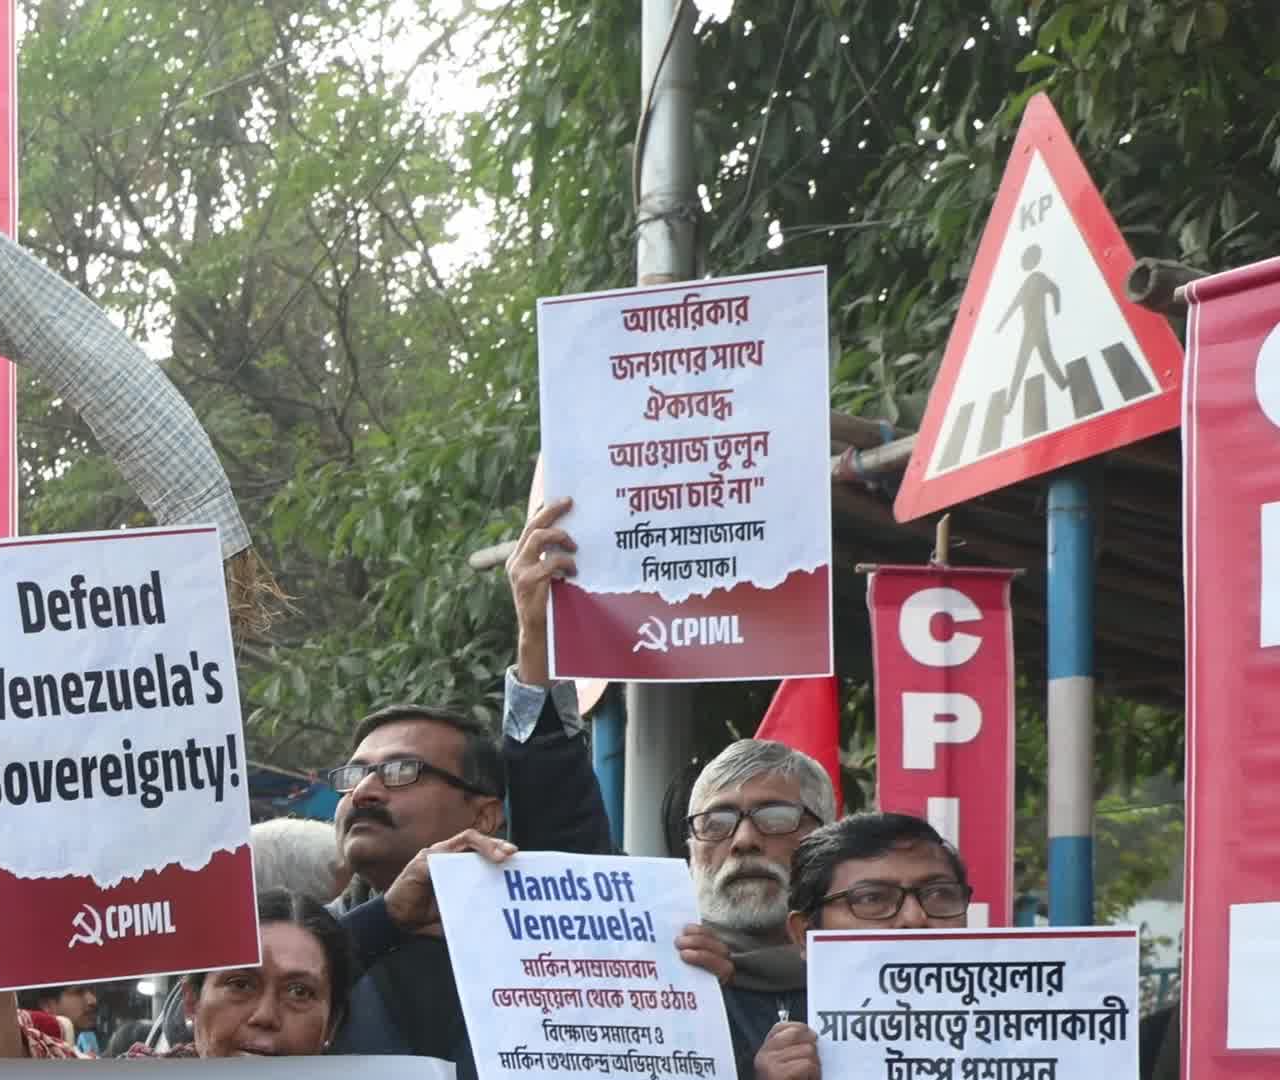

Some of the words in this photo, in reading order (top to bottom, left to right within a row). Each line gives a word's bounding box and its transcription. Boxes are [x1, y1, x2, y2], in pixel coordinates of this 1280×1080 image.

[1017, 193, 1055, 233] KP
[621, 294, 750, 334] আমেরিকার
[609, 350, 711, 382] জনগণের
[710, 340, 766, 370] সাথে
[642, 386, 735, 421] ঐক্যবদ্ধ
[608, 439, 712, 470] আওয়াজ
[712, 430, 770, 470] তুলুন
[616, 484, 683, 516] "রাজা
[684, 472, 727, 508] চাই
[727, 477, 765, 506] না"
[615, 520, 668, 550] মার্কিন
[669, 520, 767, 548] সাম্রাজ্যবাদ
[641, 556, 696, 583] নিপাত
[696, 555, 737, 580] যাক।
[16, 569, 167, 634] Defend
[671, 615, 744, 647] CPIML
[503, 868, 593, 904] Hands
[596, 870, 636, 904] Off
[105, 901, 177, 939] CPIML
[502, 907, 657, 944] Venezuela!
[519, 951, 570, 978] মার্কিন
[571, 957, 659, 981] সাম্রাজ্যবাদ
[878, 961, 1067, 1004] ভেনেজুয়েলার
[491, 988, 583, 1015] ভেনেজুয়েলা
[584, 988, 624, 1009] থেকে
[629, 992, 660, 1011] হাত
[659, 983, 698, 1011] ওঠাও
[542, 1018, 598, 1044] বিক্ষোভ
[598, 1025, 653, 1047] সমাবেশ
[653, 1027, 665, 1046] ও
[817, 998, 969, 1050] সার্বভৌমত্বে
[973, 996, 1130, 1046] হামলাকারী
[497, 1045, 545, 1071] মার্কিন
[671, 1050, 717, 1080] মিছিল
